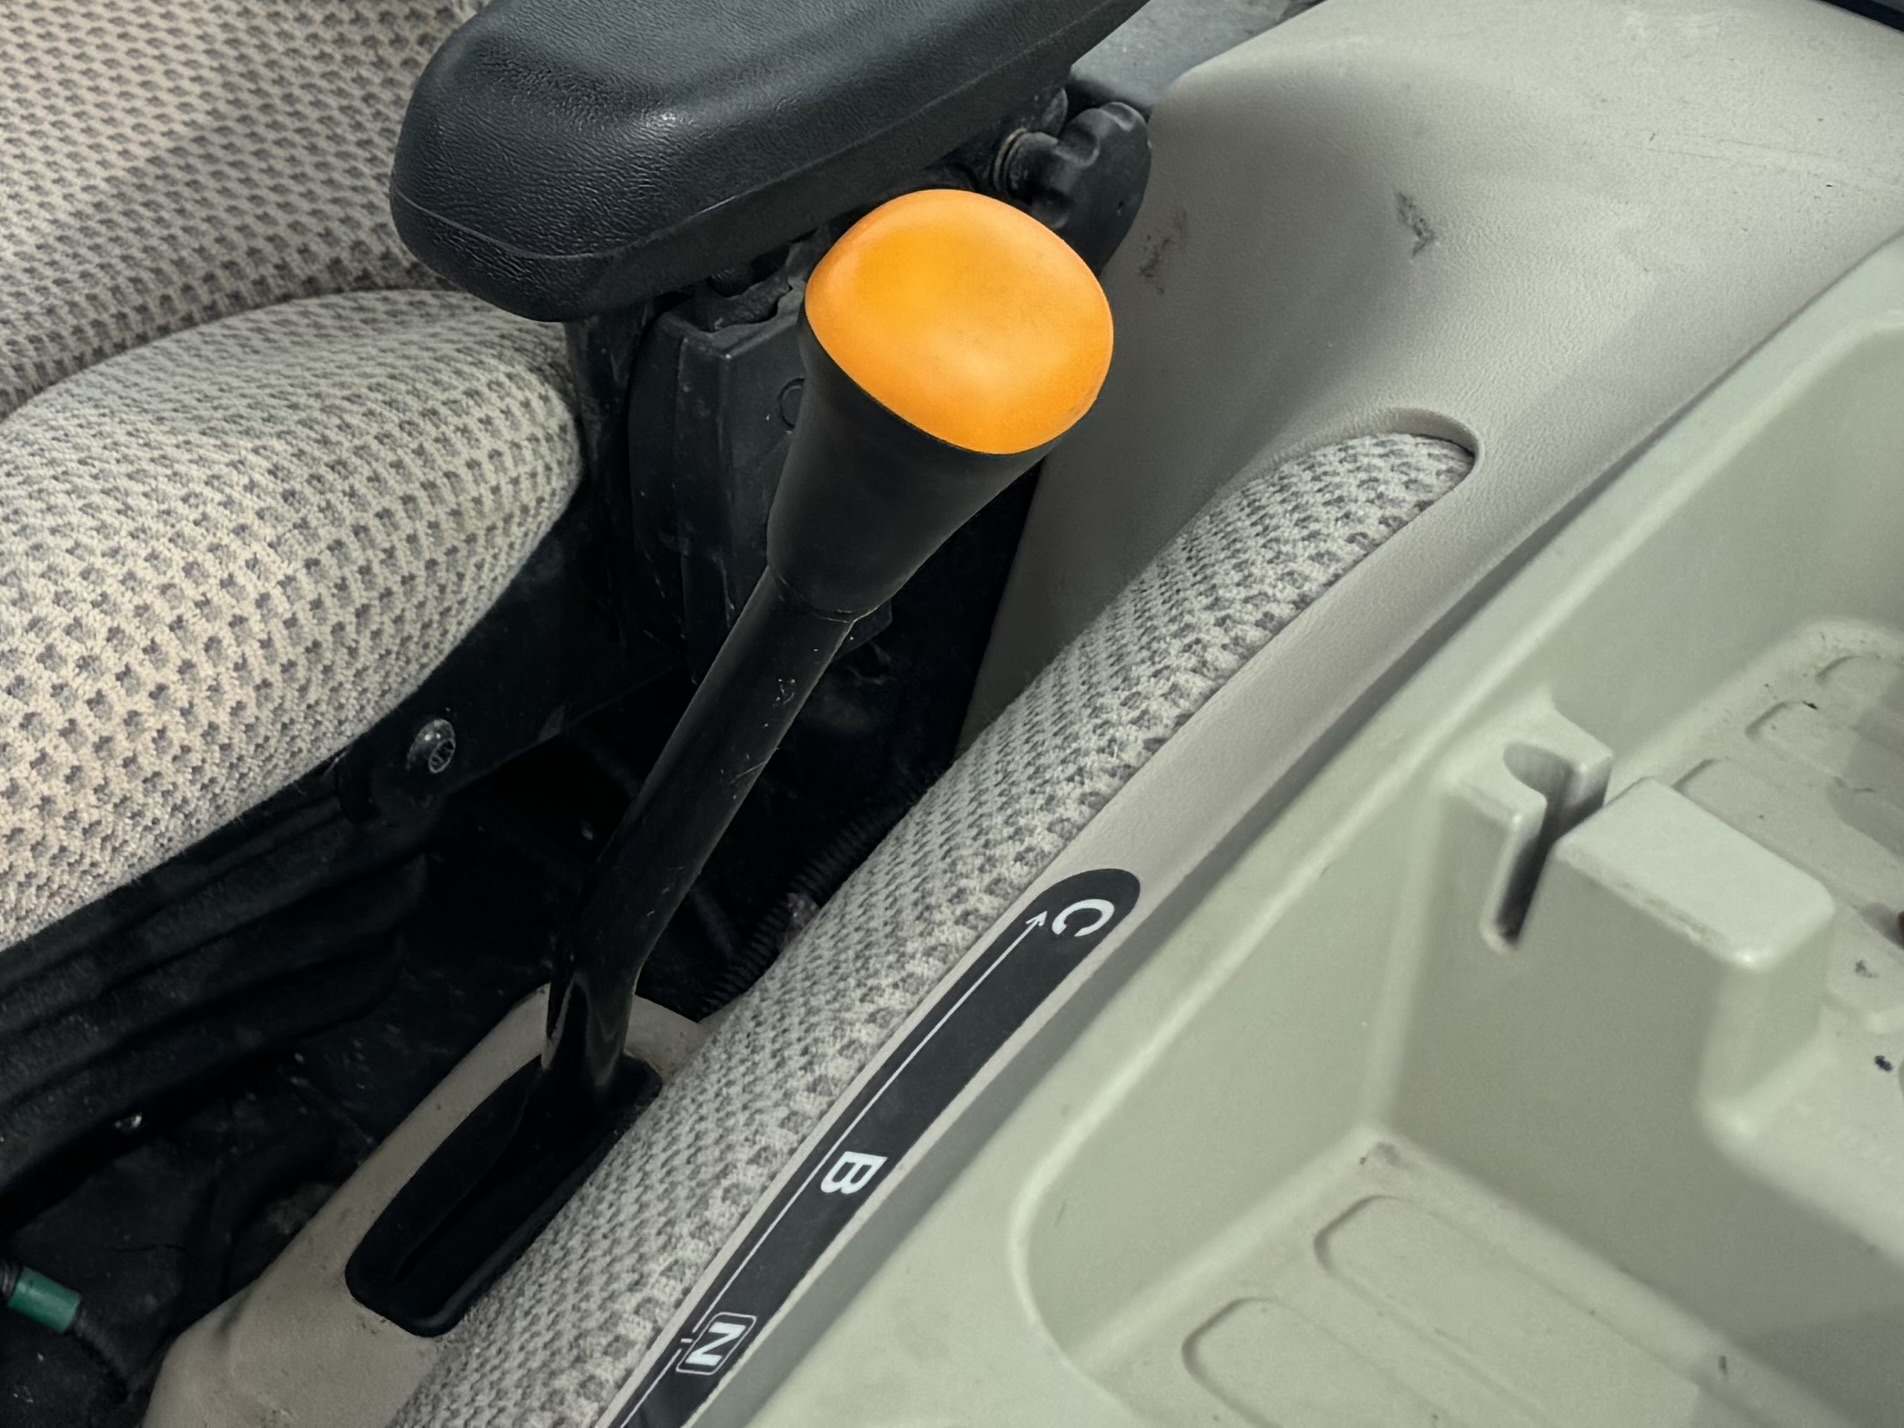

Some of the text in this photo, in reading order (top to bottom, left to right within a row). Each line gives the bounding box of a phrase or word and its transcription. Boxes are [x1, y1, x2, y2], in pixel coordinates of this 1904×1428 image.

[1050, 897, 1115, 938] C
[820, 1152, 888, 1195] B
[685, 1321, 744, 1368] N
